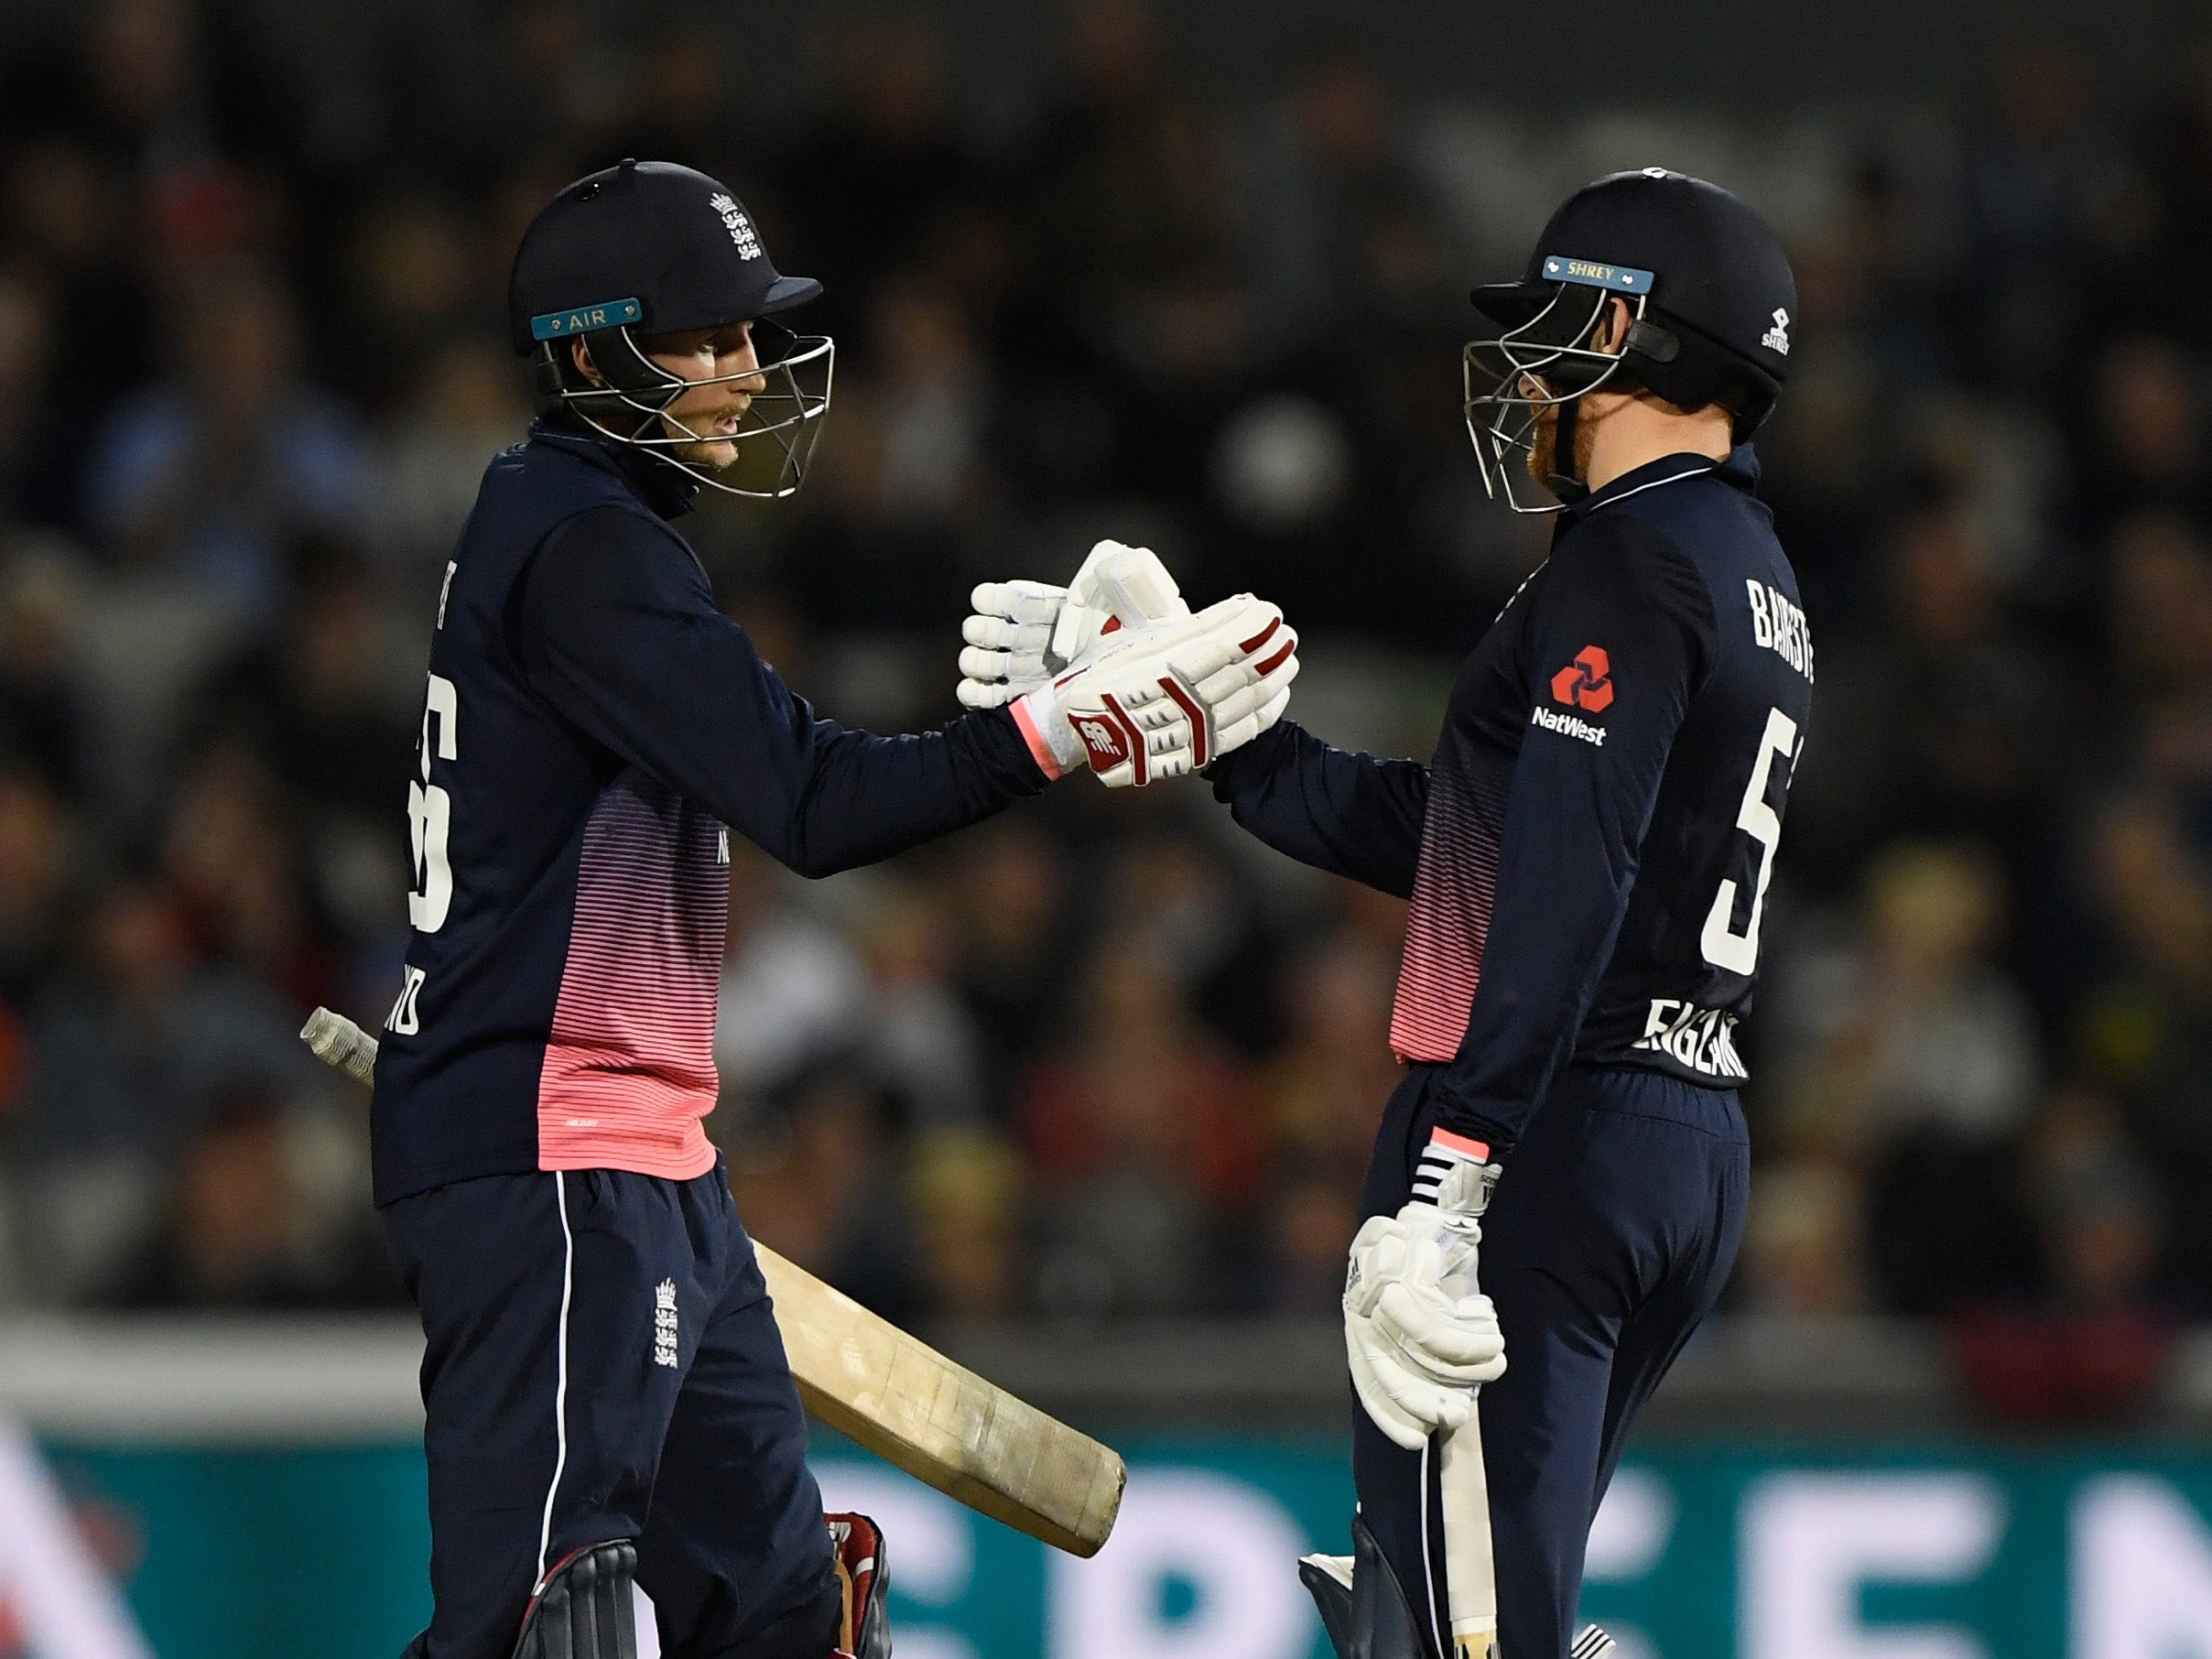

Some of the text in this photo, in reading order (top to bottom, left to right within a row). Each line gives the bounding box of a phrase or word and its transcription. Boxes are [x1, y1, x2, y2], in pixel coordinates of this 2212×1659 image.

[1567, 261, 1614, 281] SHREY
[569, 309, 607, 331] AIR
[1745, 579, 1815, 685] BAIRST
[1532, 706, 1607, 746] NatWest
[1700, 706, 1805, 976] 5
